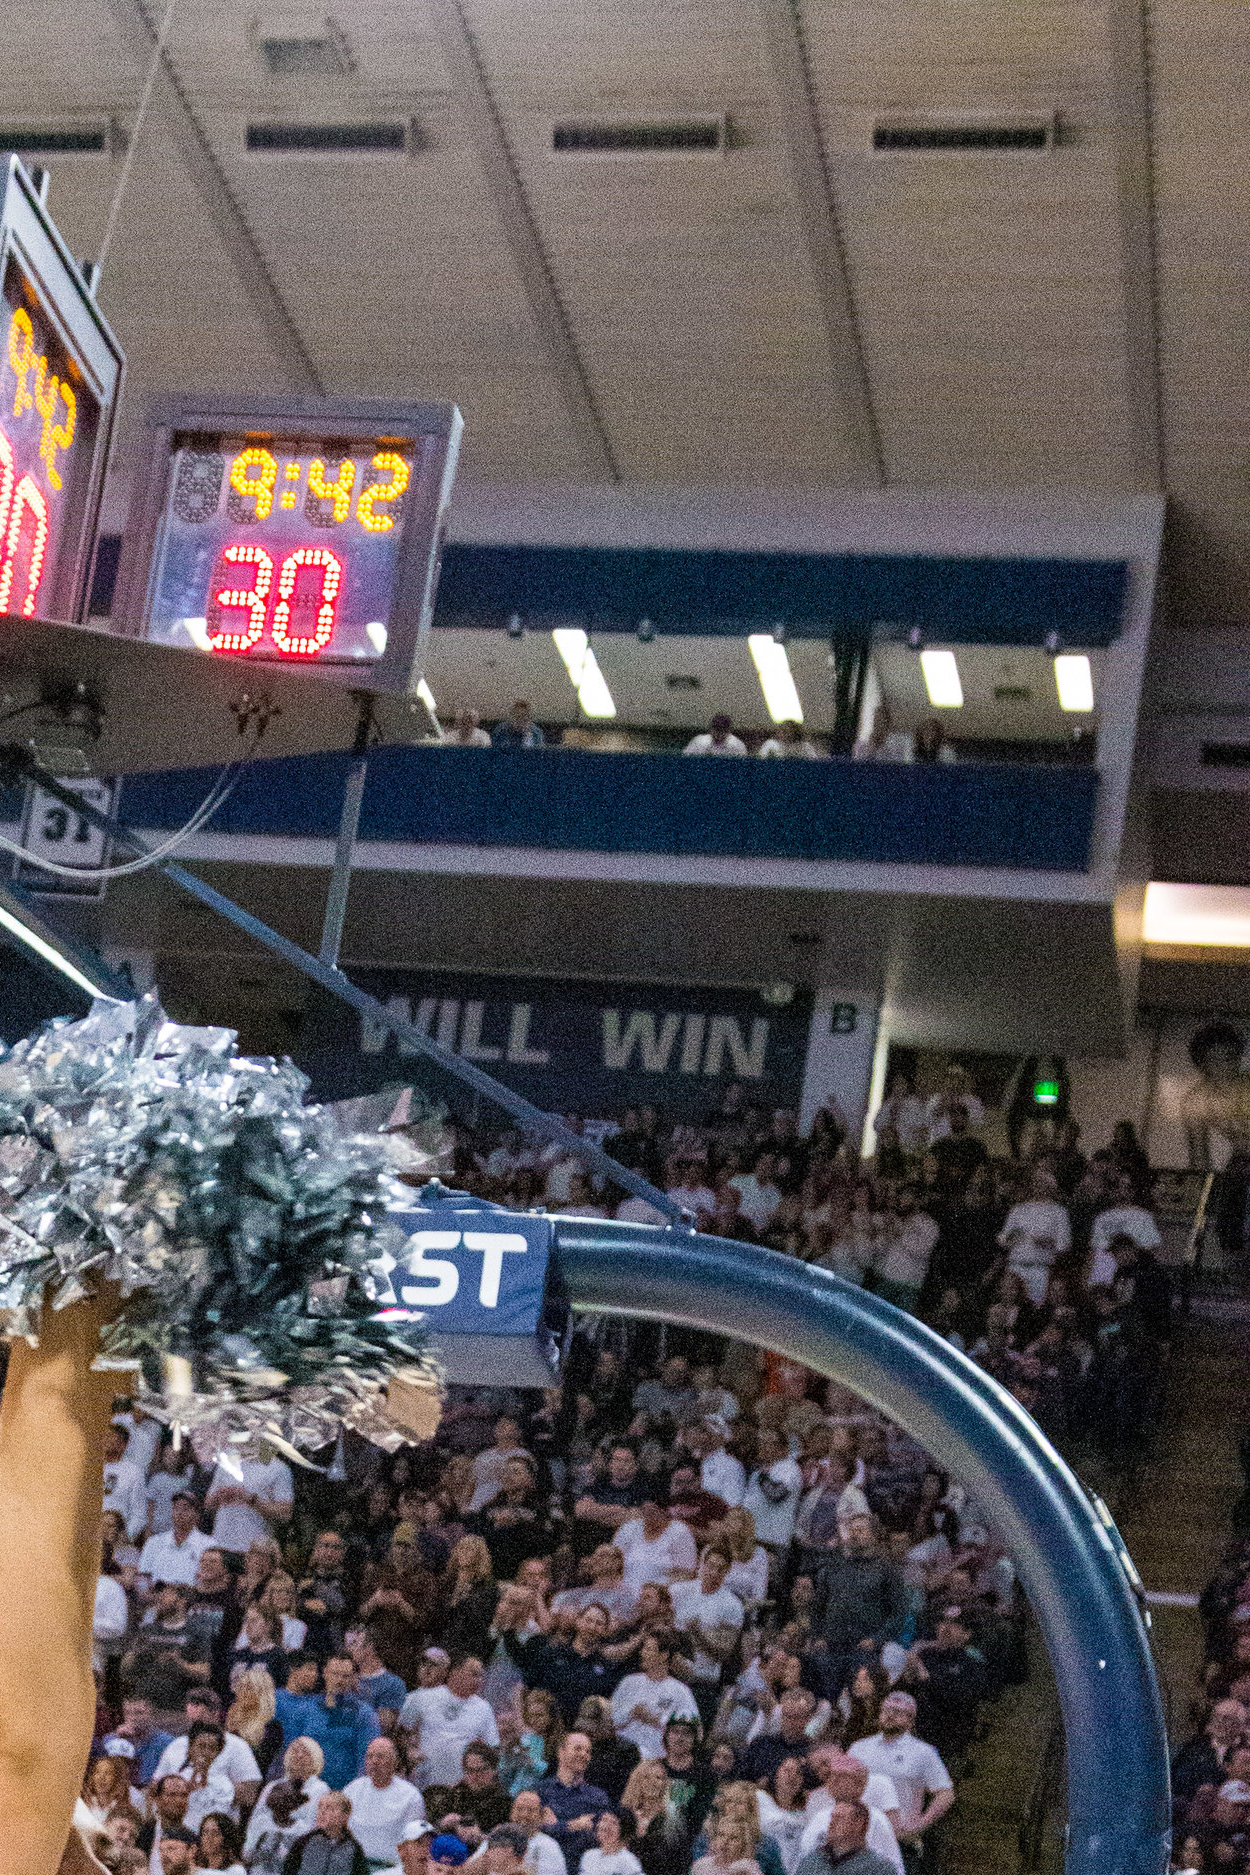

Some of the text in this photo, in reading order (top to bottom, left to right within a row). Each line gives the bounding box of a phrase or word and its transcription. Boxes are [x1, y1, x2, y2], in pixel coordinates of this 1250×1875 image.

[228, 447, 411, 533] 9:42
[209, 546, 342, 656] 30
[360, 995, 768, 1078] WILL WIN
[831, 1002, 857, 1034] B
